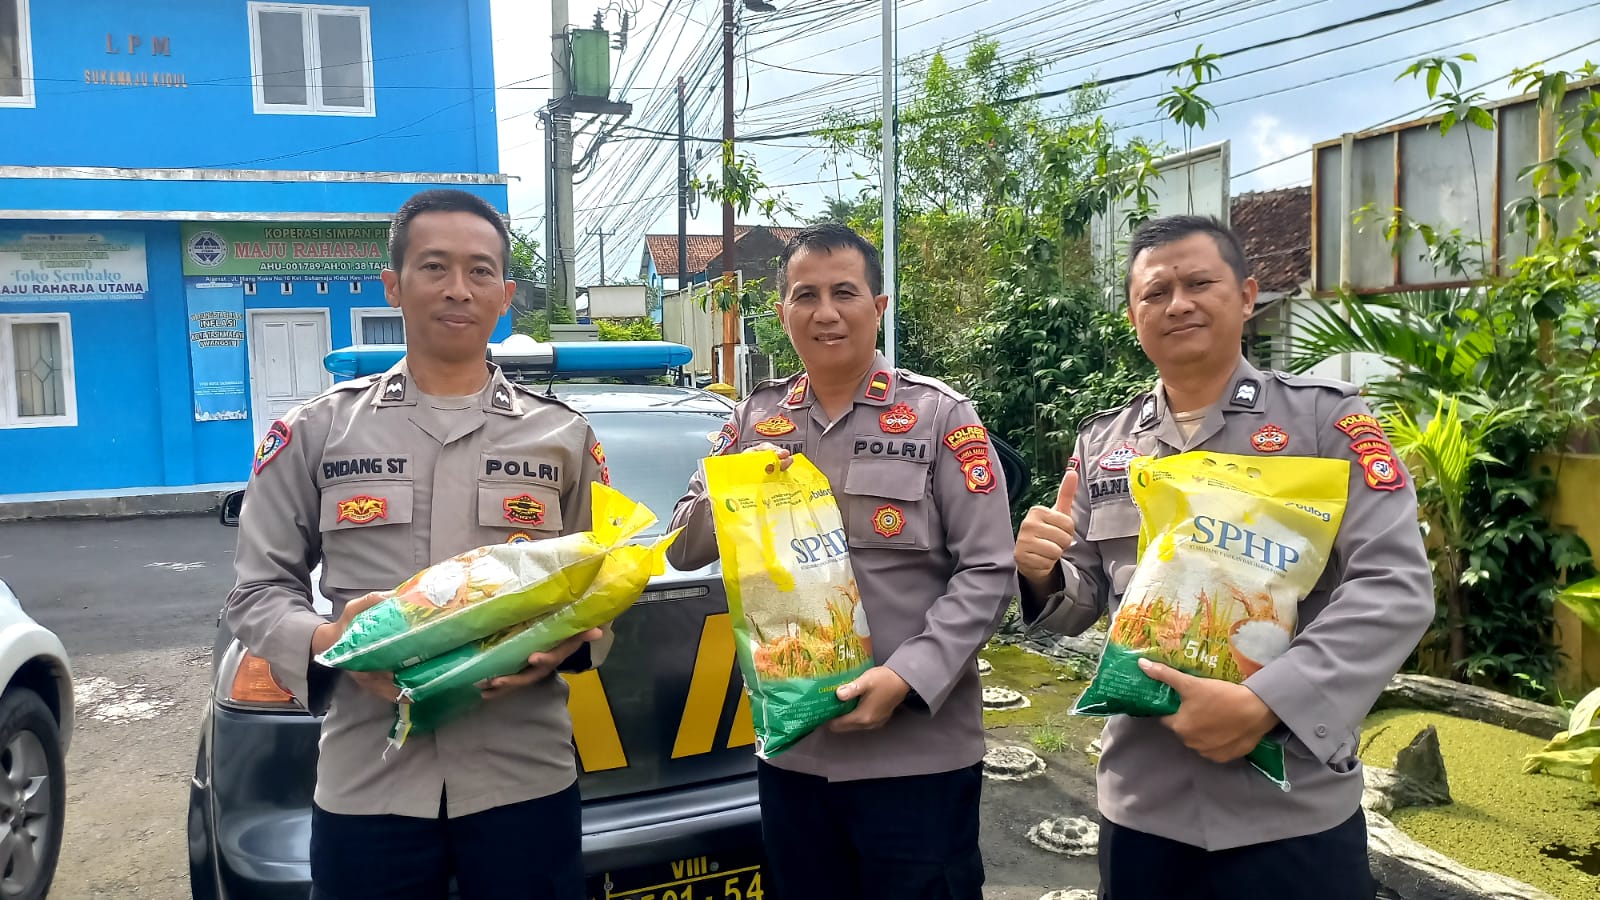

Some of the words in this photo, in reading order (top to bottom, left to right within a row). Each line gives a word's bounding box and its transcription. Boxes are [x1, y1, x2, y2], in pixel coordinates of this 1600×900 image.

[84, 68, 148, 87] SUKAMAJU
[152, 72, 188, 88] KIDUL
[265, 228, 321, 239] KOPERASI
[326, 228, 371, 239] SIMPAN
[233, 242, 286, 259] MAJU
[292, 242, 382, 259] RAHARJA
[10, 268, 49, 284] Toko
[53, 268, 122, 283] Sembako
[32, 284, 95, 293] RAHARJA
[98, 283, 144, 292] UTAMA
[854, 440, 926, 459] POLRI
[323, 459, 383, 479] ENDANG
[387, 458, 407, 474] ST
[485, 459, 559, 482] POLRI
[1191, 515, 1299, 573] SPHP
[671, 856, 708, 879] VIII
